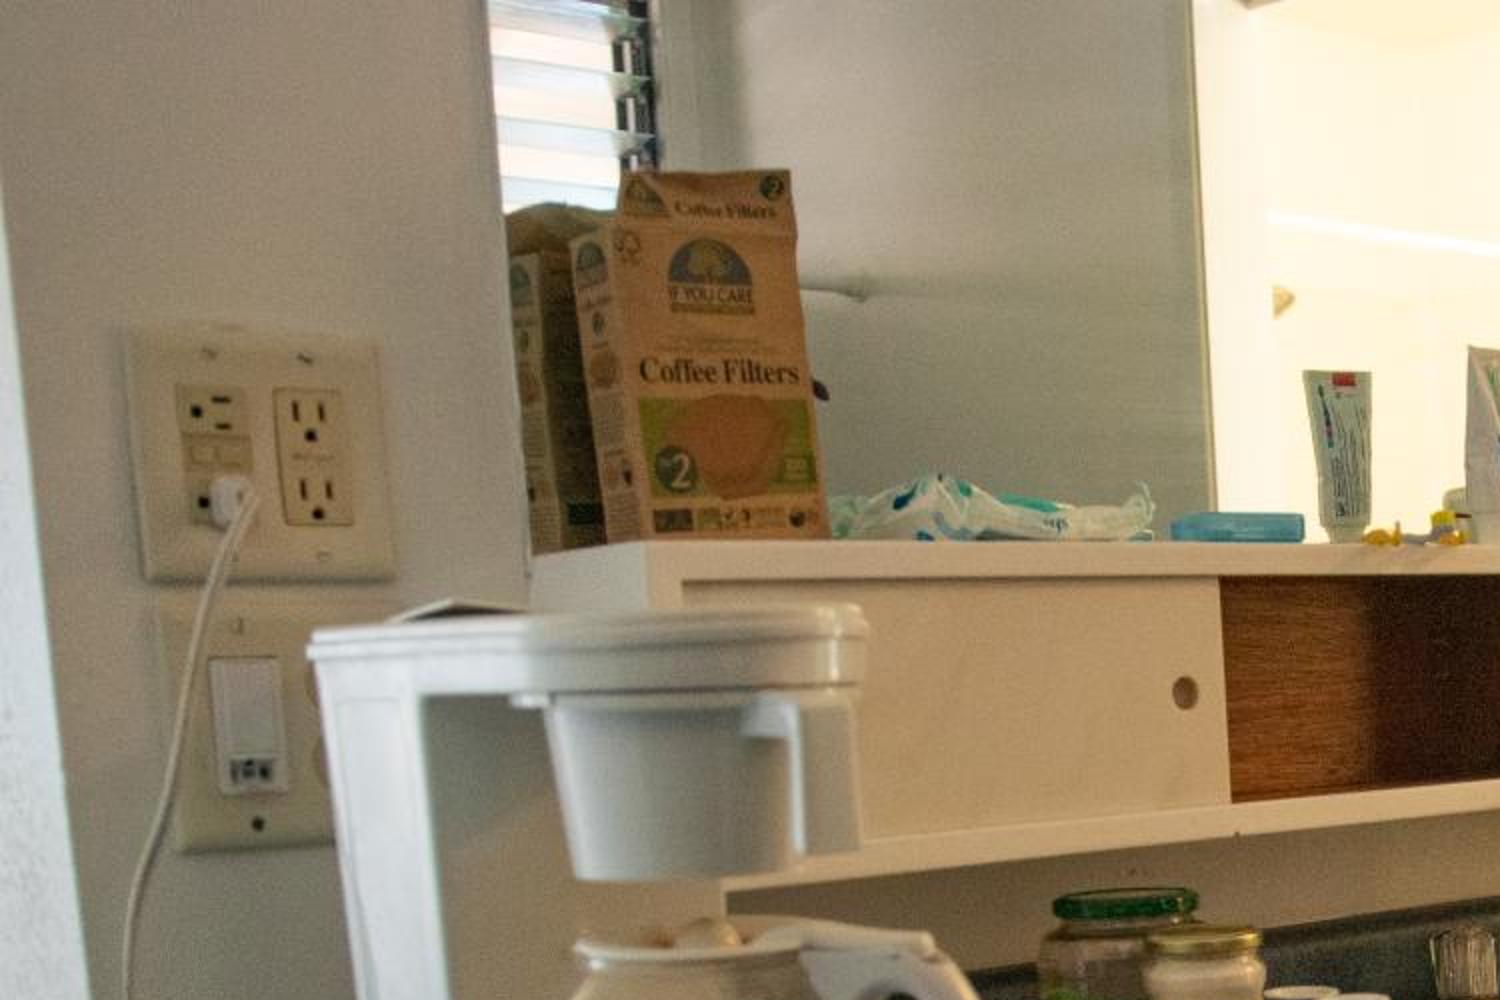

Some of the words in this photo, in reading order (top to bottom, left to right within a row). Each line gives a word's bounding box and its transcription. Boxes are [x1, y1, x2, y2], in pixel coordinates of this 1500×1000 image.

[674, 200, 722, 217] Coffee
[726, 202, 777, 219] Filters
[683, 287, 714, 303] YOU
[717, 287, 753, 304] CARE
[640, 357, 717, 384] Coffee
[722, 357, 800, 384] Filters
[671, 453, 691, 487] 2
